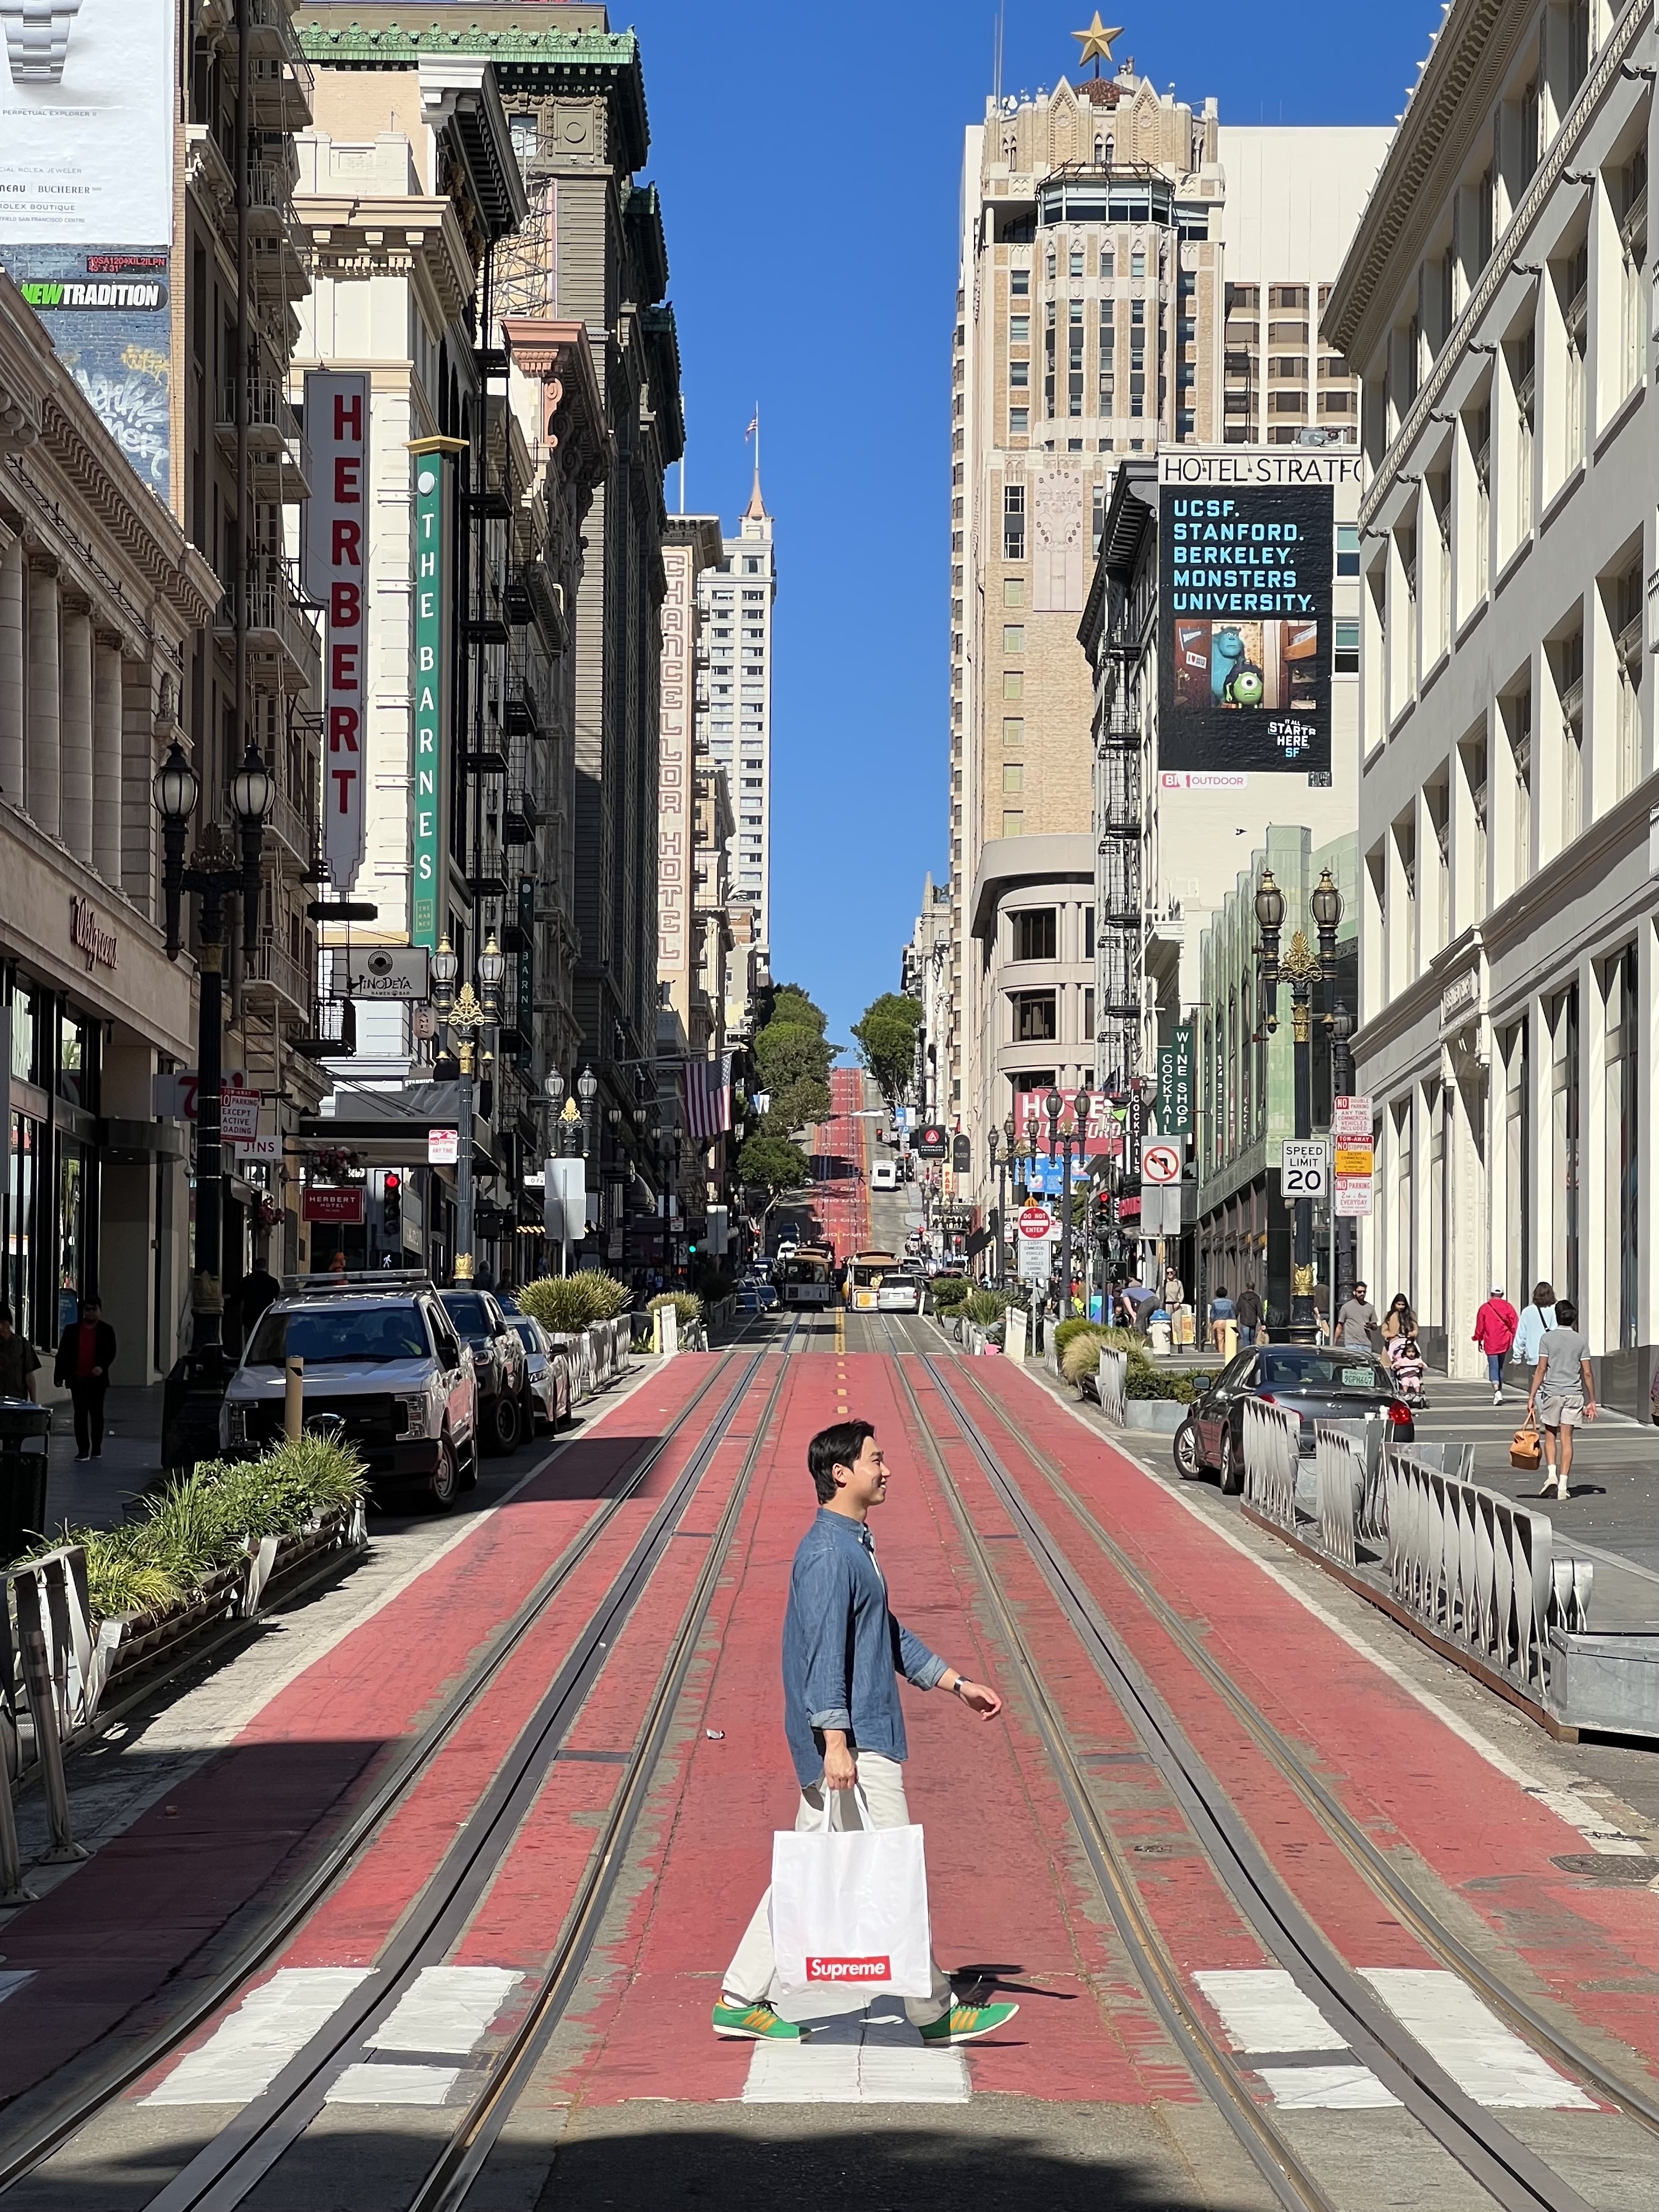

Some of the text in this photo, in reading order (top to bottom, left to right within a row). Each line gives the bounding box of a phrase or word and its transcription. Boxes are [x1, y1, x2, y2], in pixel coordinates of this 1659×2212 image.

[1165, 458, 1248, 482] HOTEL
[1174, 499, 1240, 517] UCSF.
[1174, 523, 1304, 541] STANFORD.
[1174, 547, 1295, 565] BERKELEY.
[420, 513, 435, 618] THE
[1174, 570, 1296, 587] MONSTERS
[329, 395, 363, 814] HERBERT
[1174, 593, 1316, 611] UNIVERSITY.
[1269, 721, 1316, 735] STARTS
[1277, 735, 1309, 747] HERE
[1285, 747, 1300, 757] SF
[419, 646, 434, 880] BARNES
[1192, 777, 1244, 785] OUTDOOR
[658, 832, 683, 959] HOTEL
[1176, 1032, 1189, 1126] WINE SHOP
[232, 1098, 258, 1107] PARKING
[1162, 1054, 1173, 1136] COCKTAIL
[1337, 1098, 1348, 1108] NO
[222, 1108, 251, 1117] EXCEPT
[221, 1125, 252, 1135] OADING
[222, 1117, 249, 1126] ACTIVE
[1286, 1146, 1323, 1155] SPEED
[1337, 1142, 1348, 1150] NO
[1290, 1158, 1319, 1167] LIMIT
[1288, 1170, 1321, 1190] 20
[1337, 1180, 1347, 1190] NO
[811, 1959, 886, 1980] Supreme
